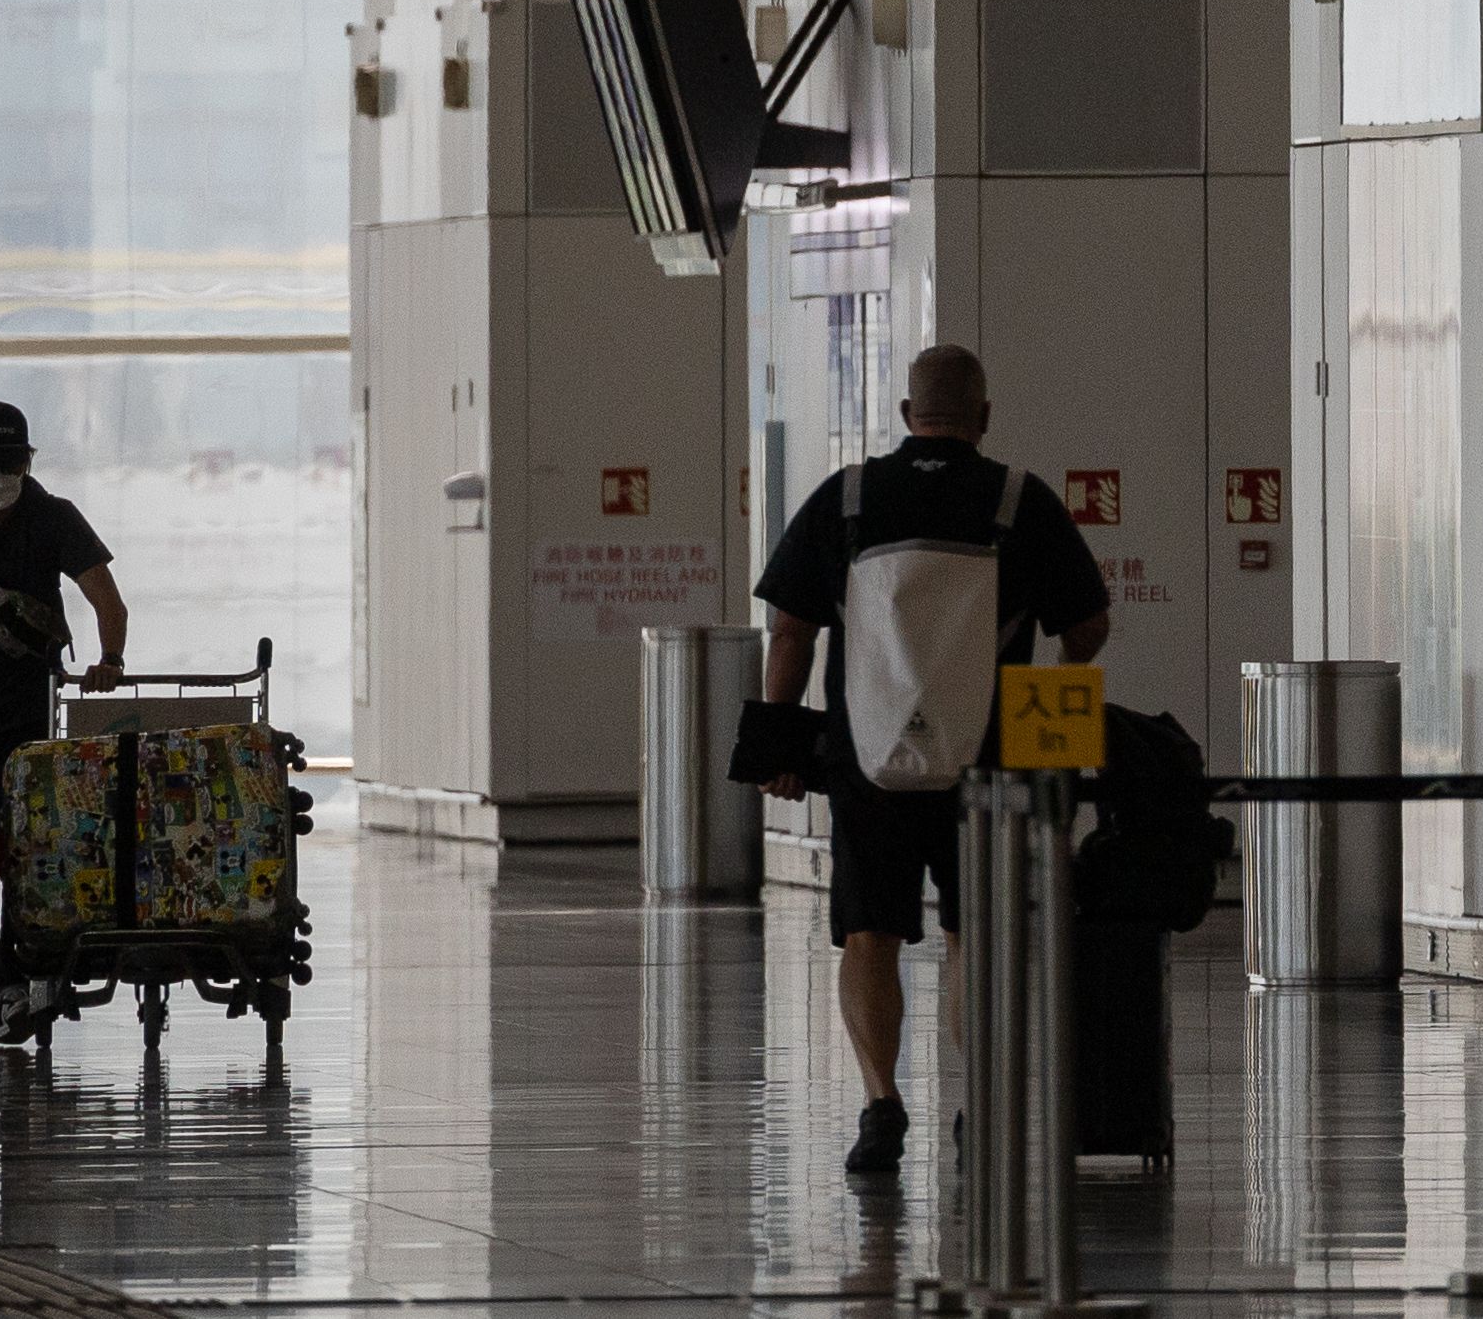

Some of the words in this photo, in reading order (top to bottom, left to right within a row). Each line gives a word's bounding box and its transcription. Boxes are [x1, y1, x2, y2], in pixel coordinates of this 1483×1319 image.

[532, 568, 568, 584] FIRE
[576, 568, 624, 583] HOSE
[629, 567, 670, 583] REEL
[678, 566, 718, 583] AND
[561, 588, 595, 603] FIRE
[603, 587, 689, 603] HYDRANT
[1124, 585, 1173, 602] REEL
[1017, 683, 1092, 719] 入口
